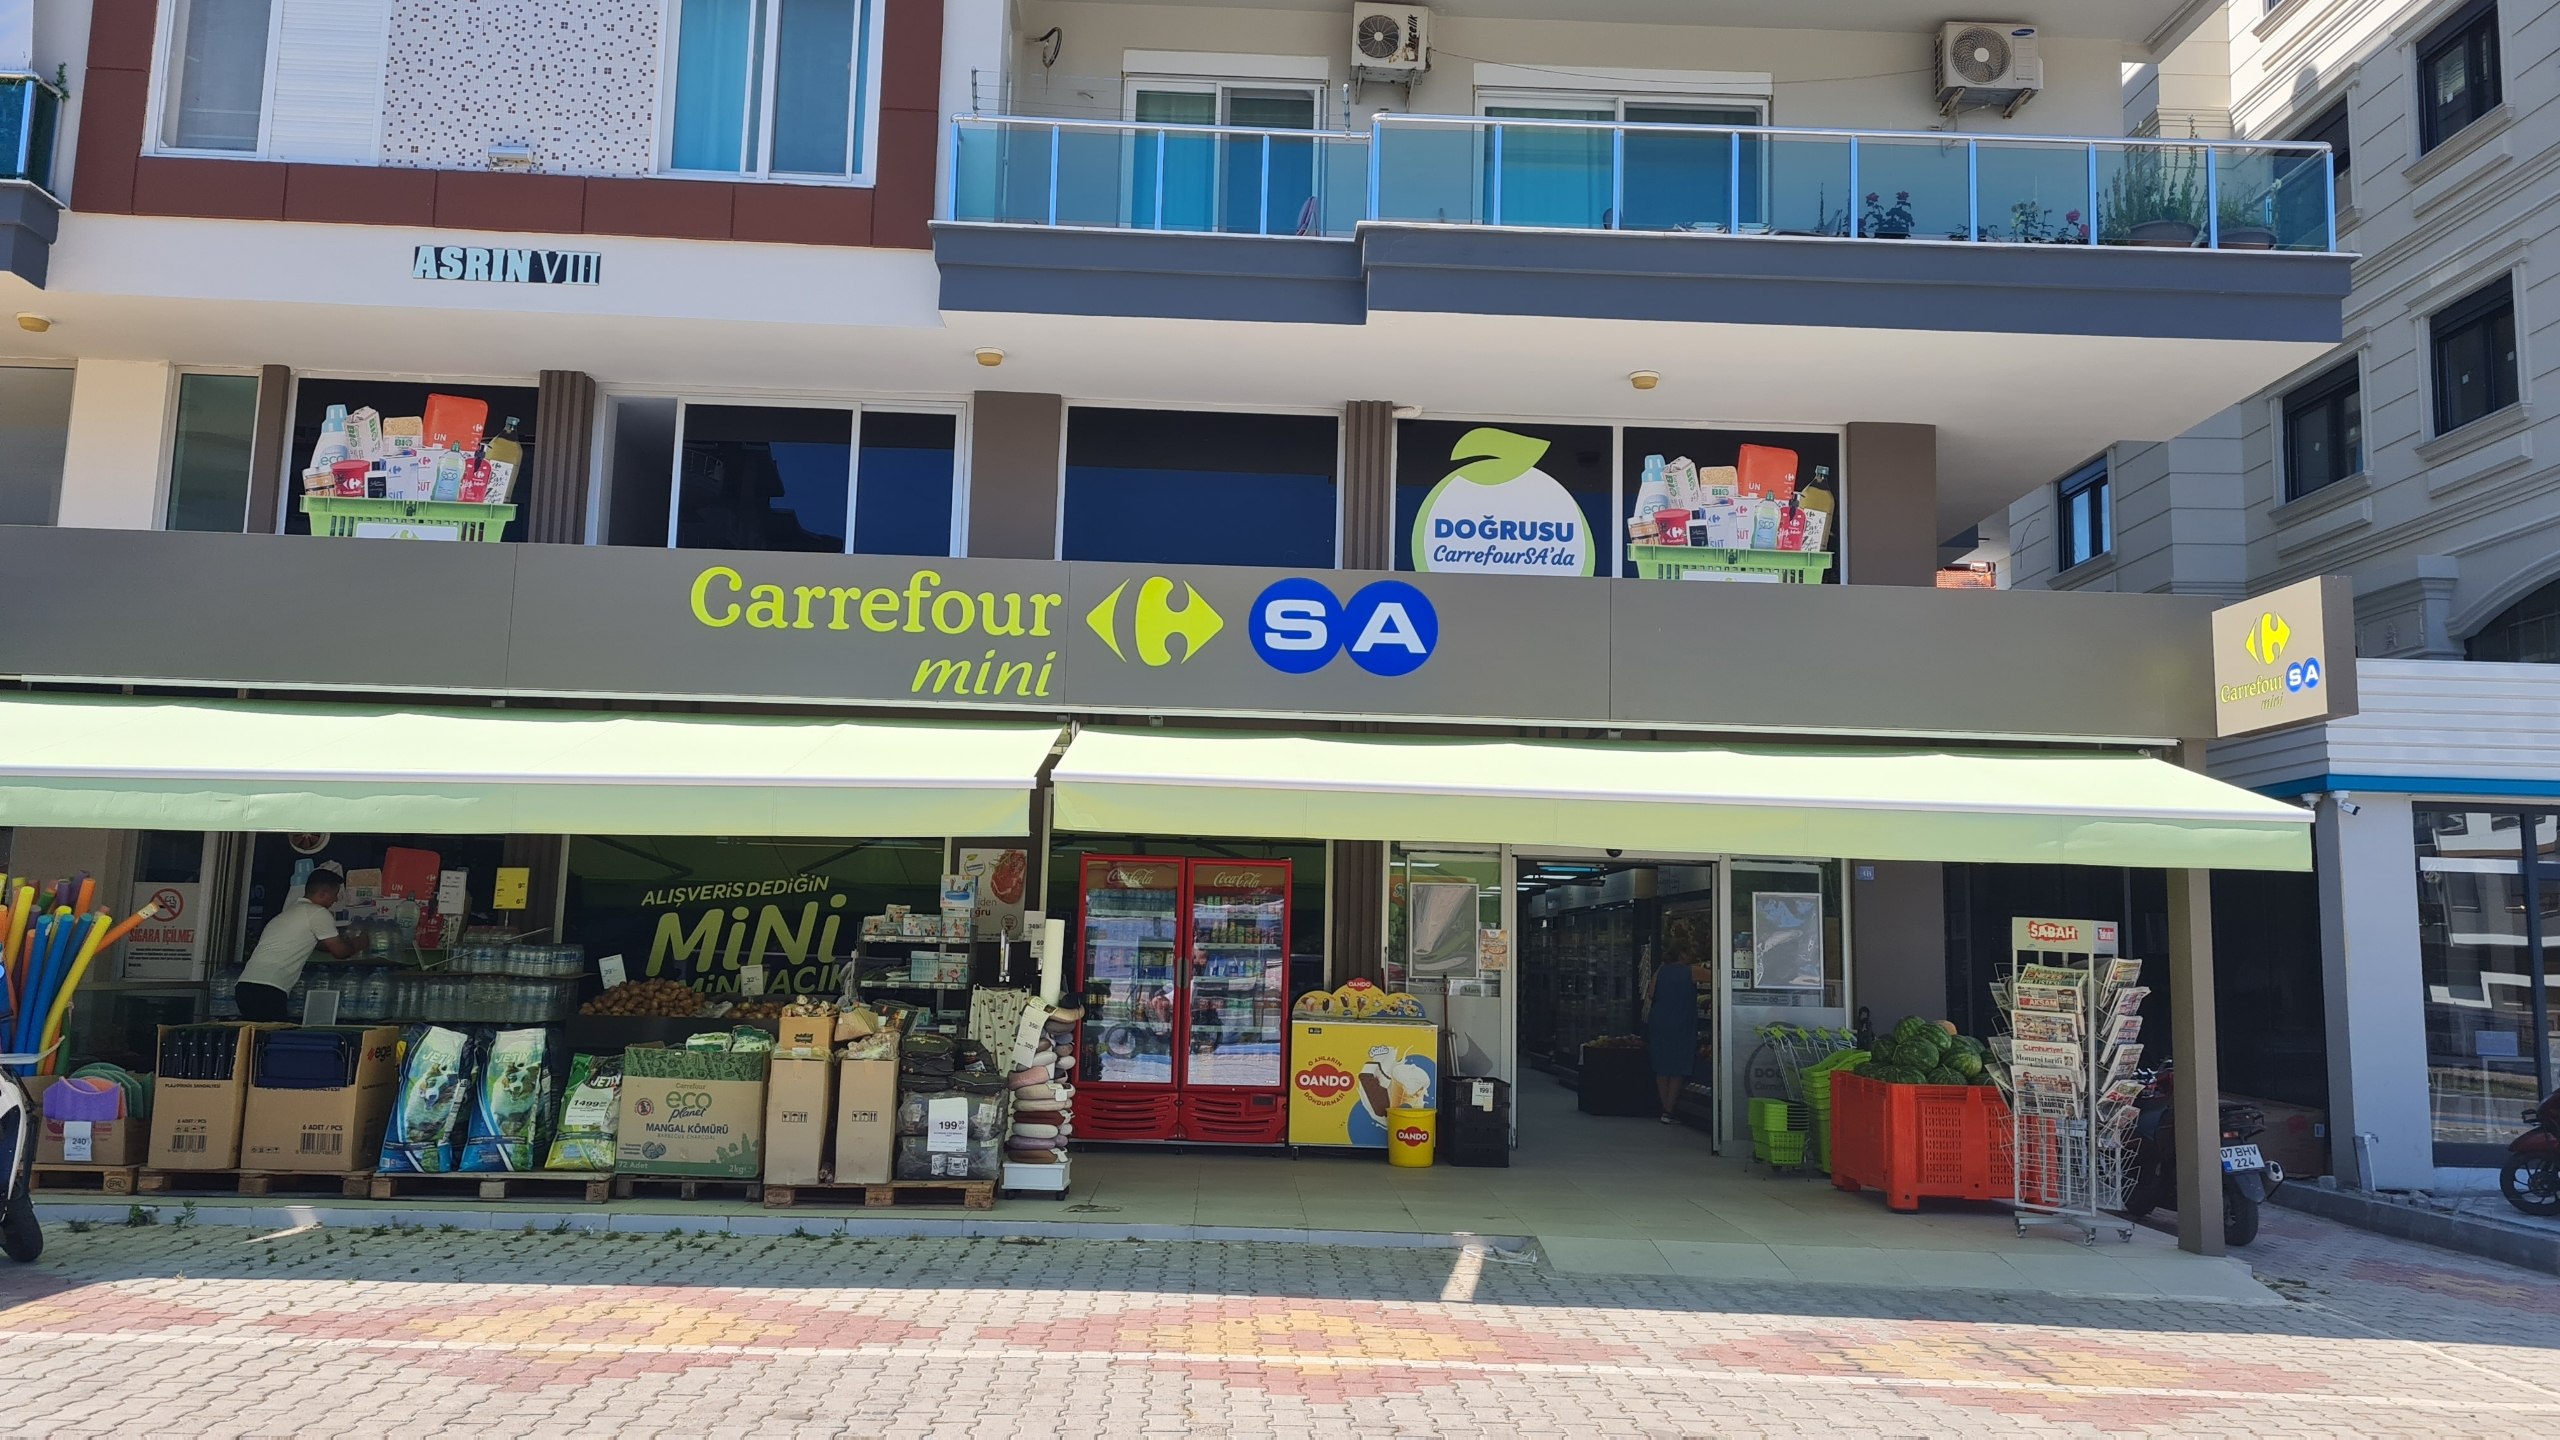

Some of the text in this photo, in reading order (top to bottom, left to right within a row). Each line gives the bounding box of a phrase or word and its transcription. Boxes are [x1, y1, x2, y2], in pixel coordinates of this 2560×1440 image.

[413, 245, 601, 286] ASRIN VIII
[394, 437, 413, 447] BIO
[433, 433, 447, 442] UN
[1711, 486, 1730, 496] BIO
[1748, 482, 1761, 491] UN
[1435, 515, 1574, 542] DOĞRUSU
[1433, 544, 1575, 566] CarrefourSA'da
[690, 566, 1062, 637] Carrefour
[911, 649, 1057, 697] mini
[2220, 674, 2284, 704] Carrefour
[2261, 692, 2284, 711] mini
[2030, 925, 2075, 939] SABAH
[675, 1082, 706, 1090] Carrefour
[1300, 1074, 1350, 1087] OANDO
[666, 1091, 712, 1109] eco
[668, 1107, 706, 1123] planet
[646, 1123, 729, 1134] MANGAL KÖMÜRÜ
[939, 1120, 958, 1130] 199
[72, 1136, 87, 1145] 240
[1398, 1131, 1428, 1141] OANDO
[2220, 1145, 2257, 1159] 07 BHV
[629, 1161, 649, 1169] Adet
[2234, 1157, 2255, 1168] 224
